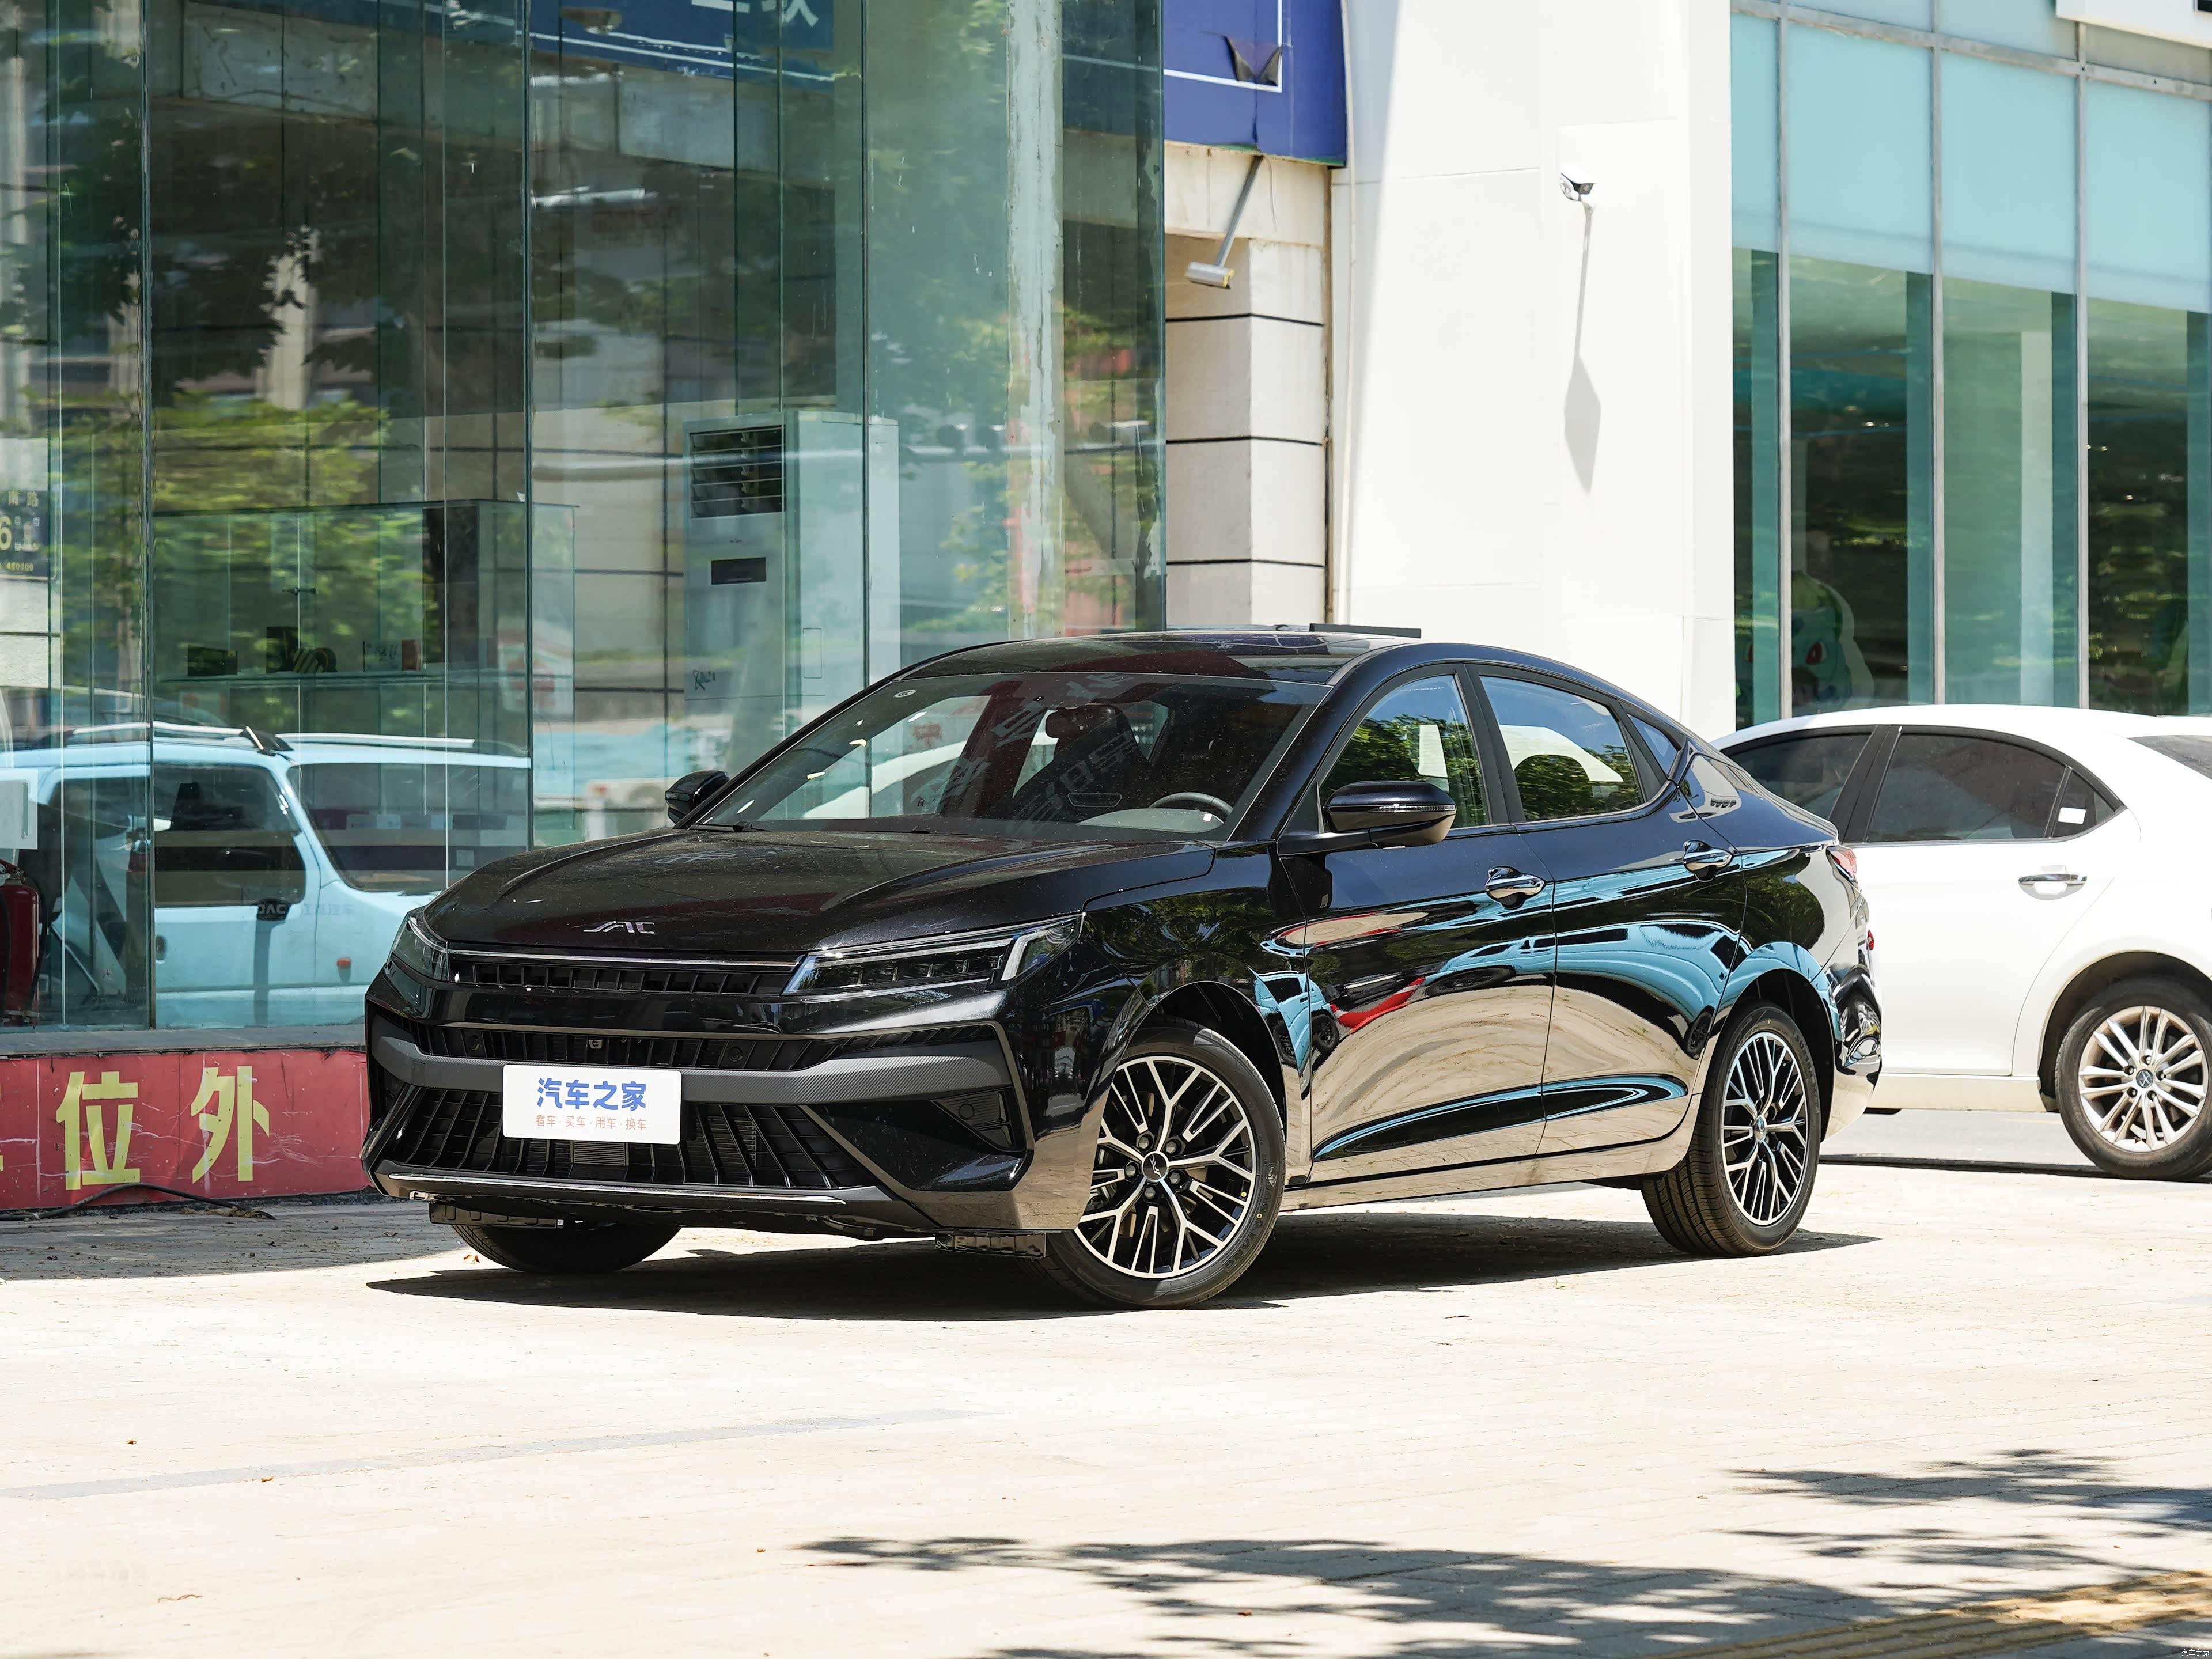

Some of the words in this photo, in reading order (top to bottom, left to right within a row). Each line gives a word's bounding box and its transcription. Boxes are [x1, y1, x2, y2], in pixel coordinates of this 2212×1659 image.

[583, 921, 654, 933] JAC
[537, 1078, 646, 1111] 汽车之家
[0, 1065, 270, 1191] 位外
